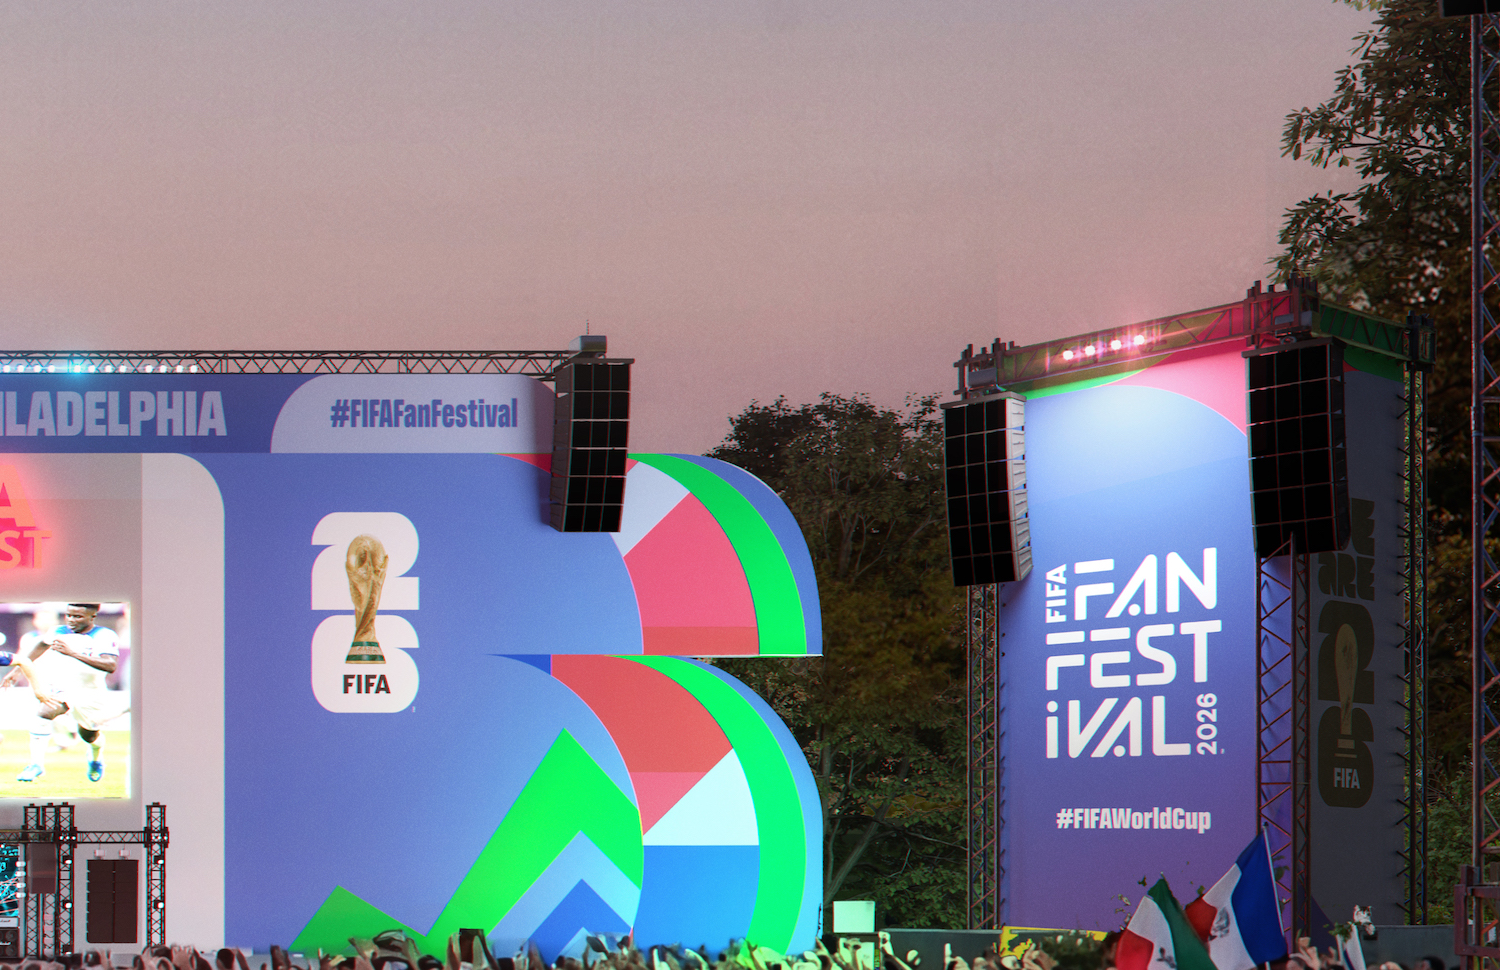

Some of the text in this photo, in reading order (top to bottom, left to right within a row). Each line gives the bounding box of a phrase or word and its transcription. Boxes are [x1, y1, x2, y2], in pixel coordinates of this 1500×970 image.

[330, 398, 518, 428] #FIFAFanFestival
[1046, 547, 1217, 623] FIFA FAN
[1046, 619, 1222, 690] FEST
[343, 674, 391, 694] FIFA
[1196, 693, 1218, 755] 2026
[1333, 767, 1361, 790] FIFA
[1056, 807, 1212, 834] #FIFAWorldCup
